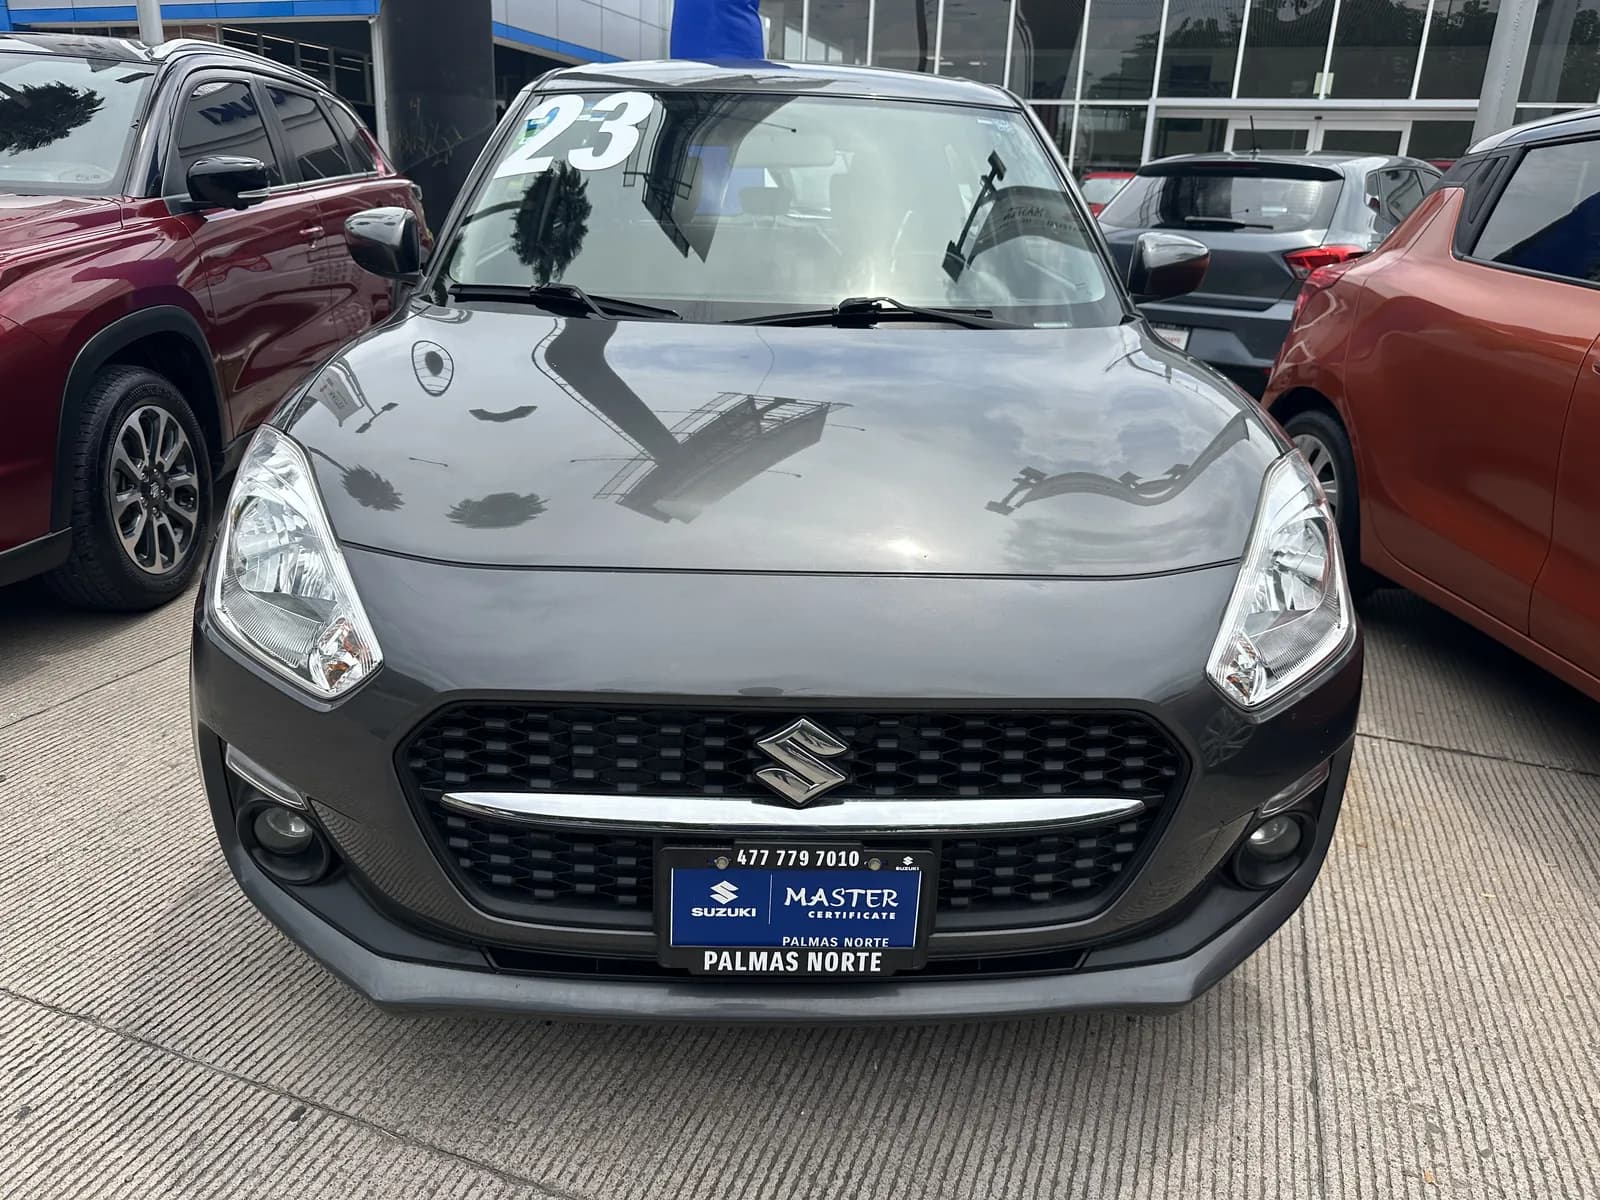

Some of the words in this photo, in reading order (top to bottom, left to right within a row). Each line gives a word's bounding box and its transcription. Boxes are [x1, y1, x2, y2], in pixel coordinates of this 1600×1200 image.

[494, 91, 655, 180] 23
[737, 850, 770, 866] 477
[776, 850, 809, 867] 779
[816, 850, 860, 867] 7010
[784, 887, 899, 908] MASTER
[691, 907, 756, 917] SUZUKI
[808, 910, 896, 920] CERTIFICATE
[782, 936, 838, 946] PALMAS
[844, 936, 889, 948] NORTE
[703, 951, 799, 972] PALMAS
[807, 952, 882, 972] NORTE
